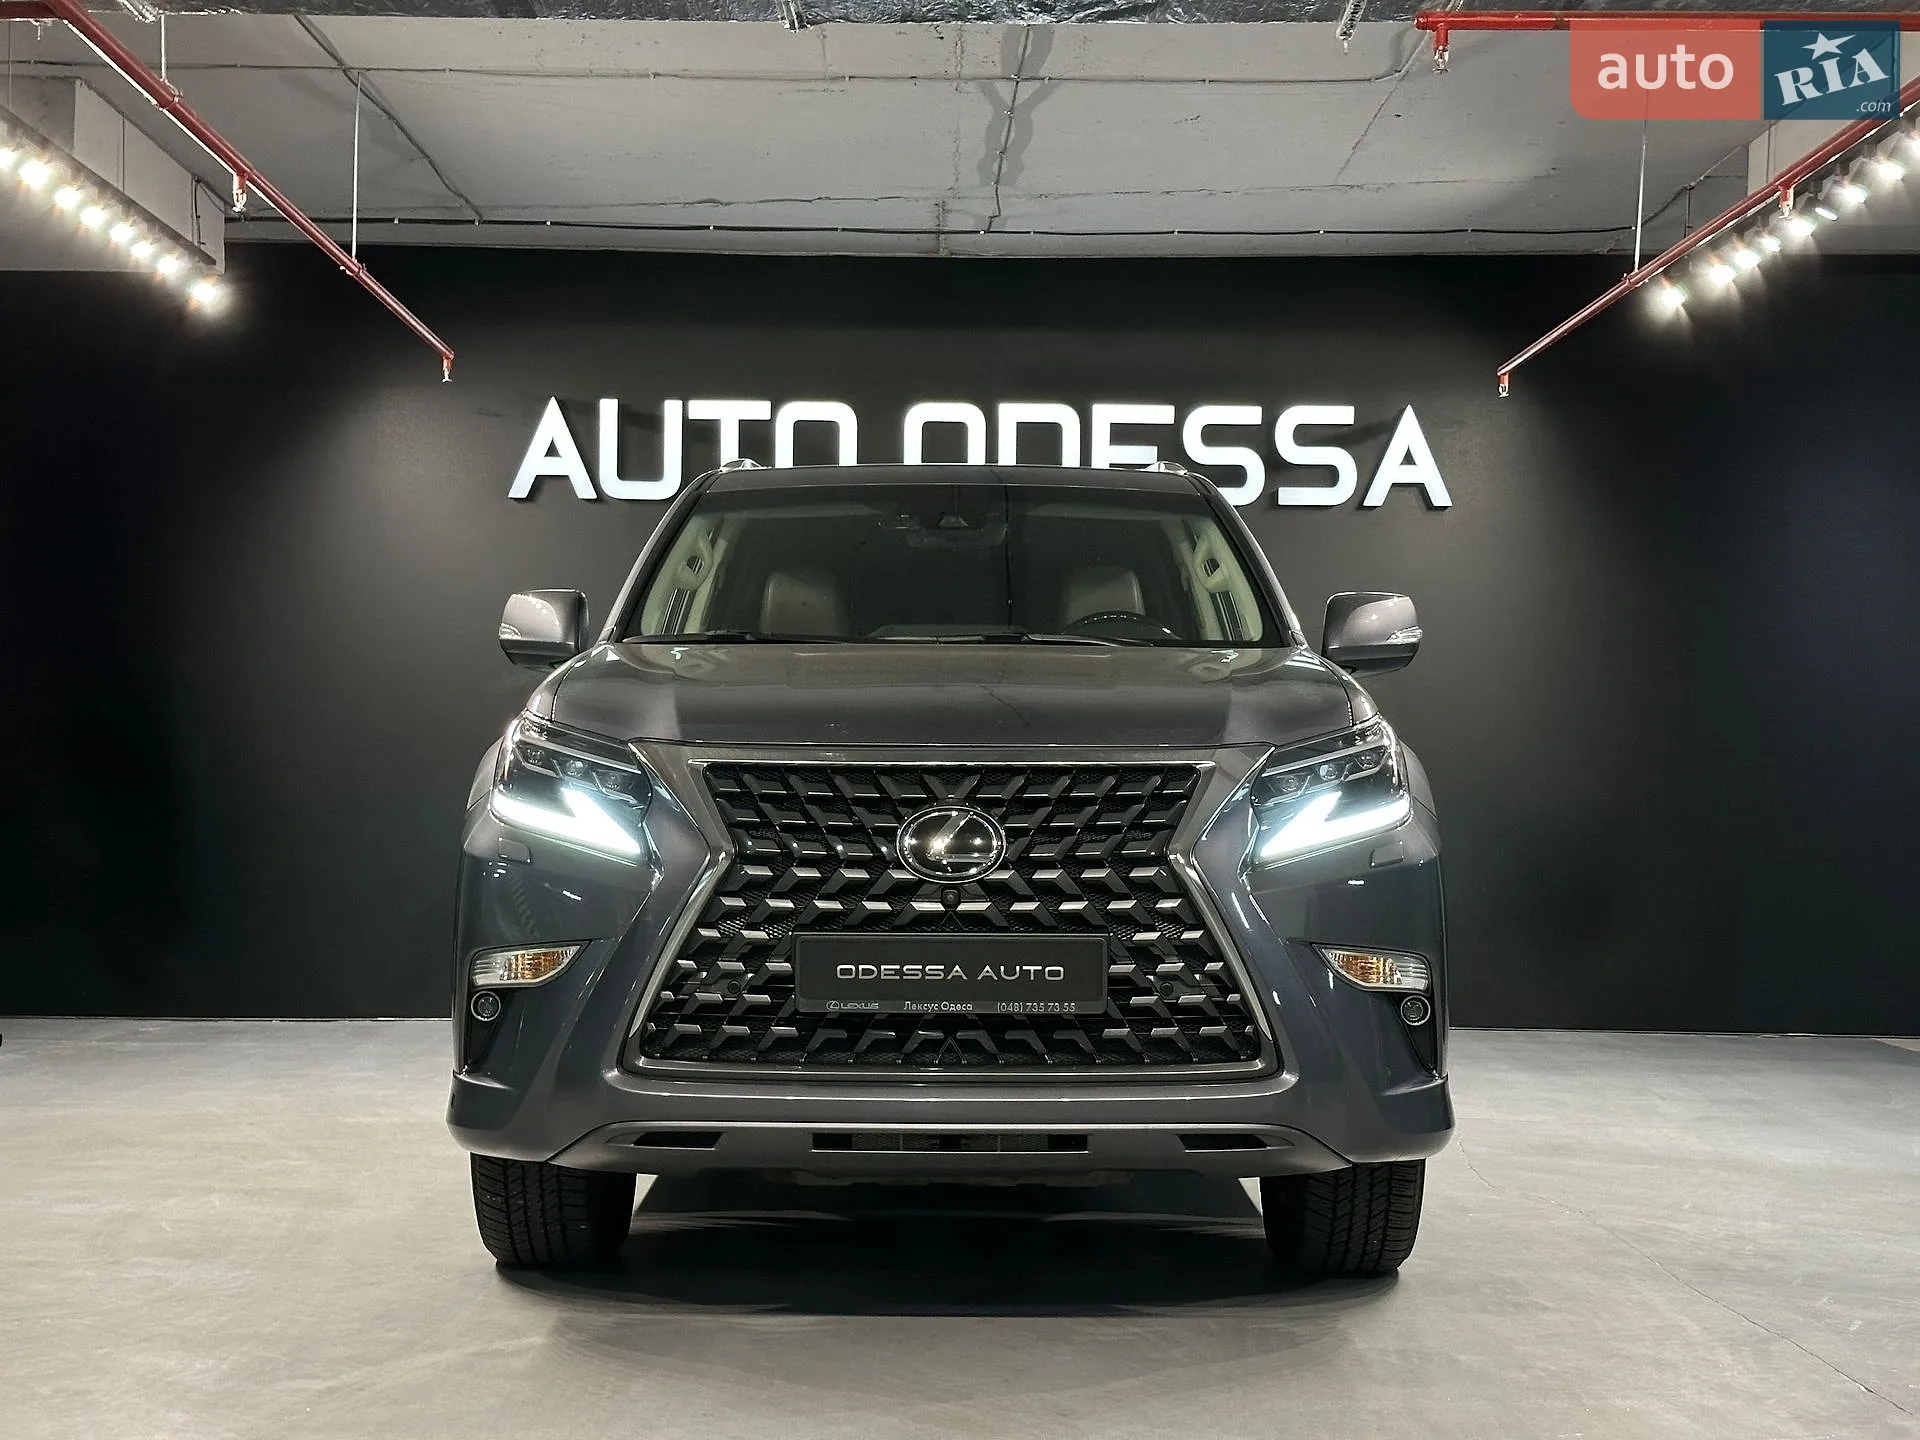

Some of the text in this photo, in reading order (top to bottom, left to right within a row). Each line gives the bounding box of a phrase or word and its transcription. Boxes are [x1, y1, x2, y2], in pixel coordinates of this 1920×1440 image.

[507, 396, 1453, 508] AUTO ODESSA
[836, 964, 1065, 981] ODESSA AUTO
[840, 1002, 880, 1010] LEXUS
[903, 1001, 973, 1013] Лексус Одеса
[997, 1002, 1076, 1013] (048) 735 73 55
